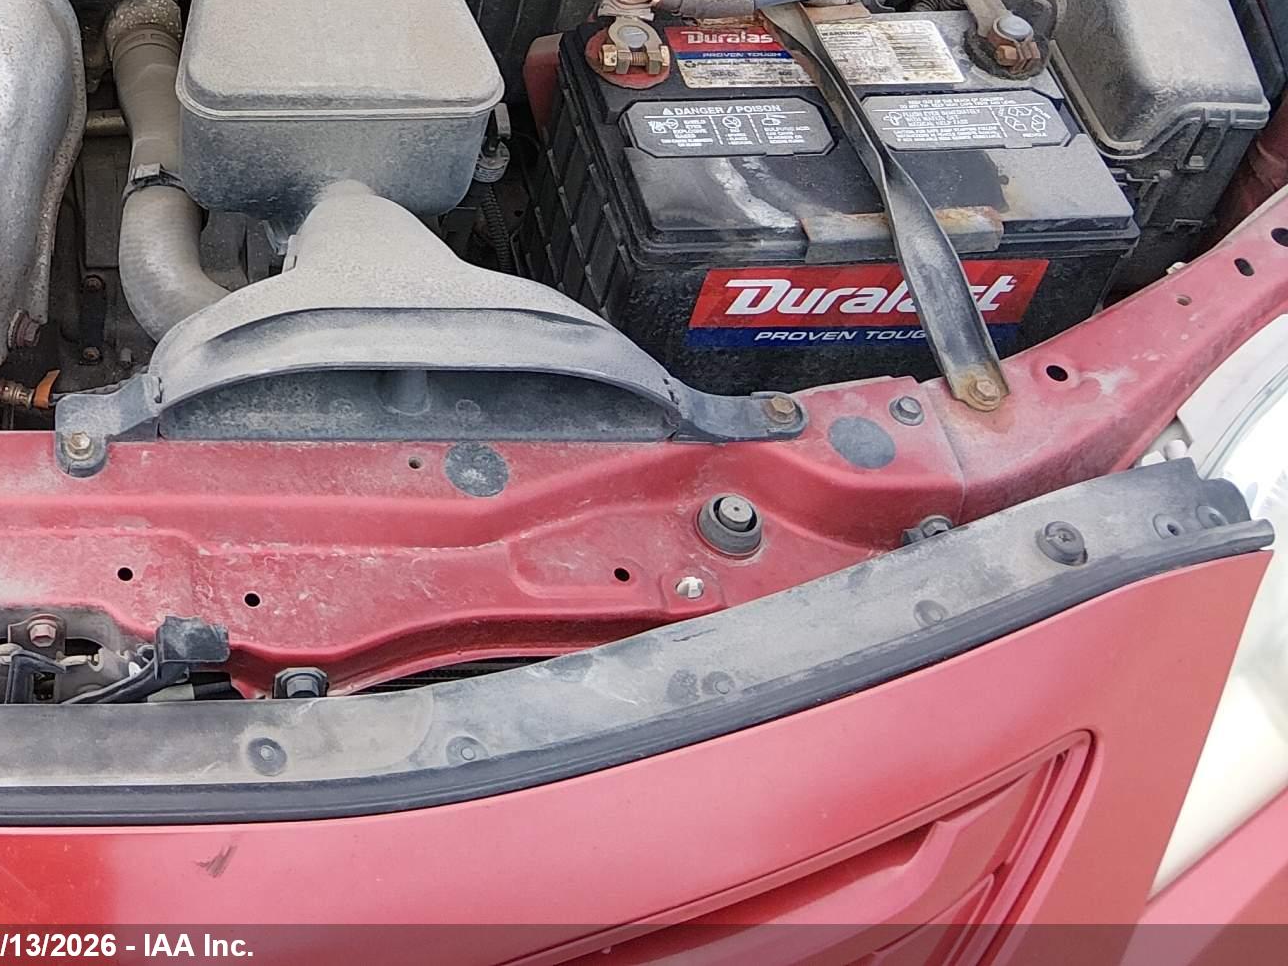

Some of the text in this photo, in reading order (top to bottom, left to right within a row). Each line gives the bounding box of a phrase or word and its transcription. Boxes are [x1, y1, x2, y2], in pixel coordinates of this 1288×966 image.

[680, 30, 775, 44] Duralas
[674, 107, 725, 115] DANGER
[736, 104, 782, 113] POISON
[754, 329, 928, 341] PROVEN TOUG
